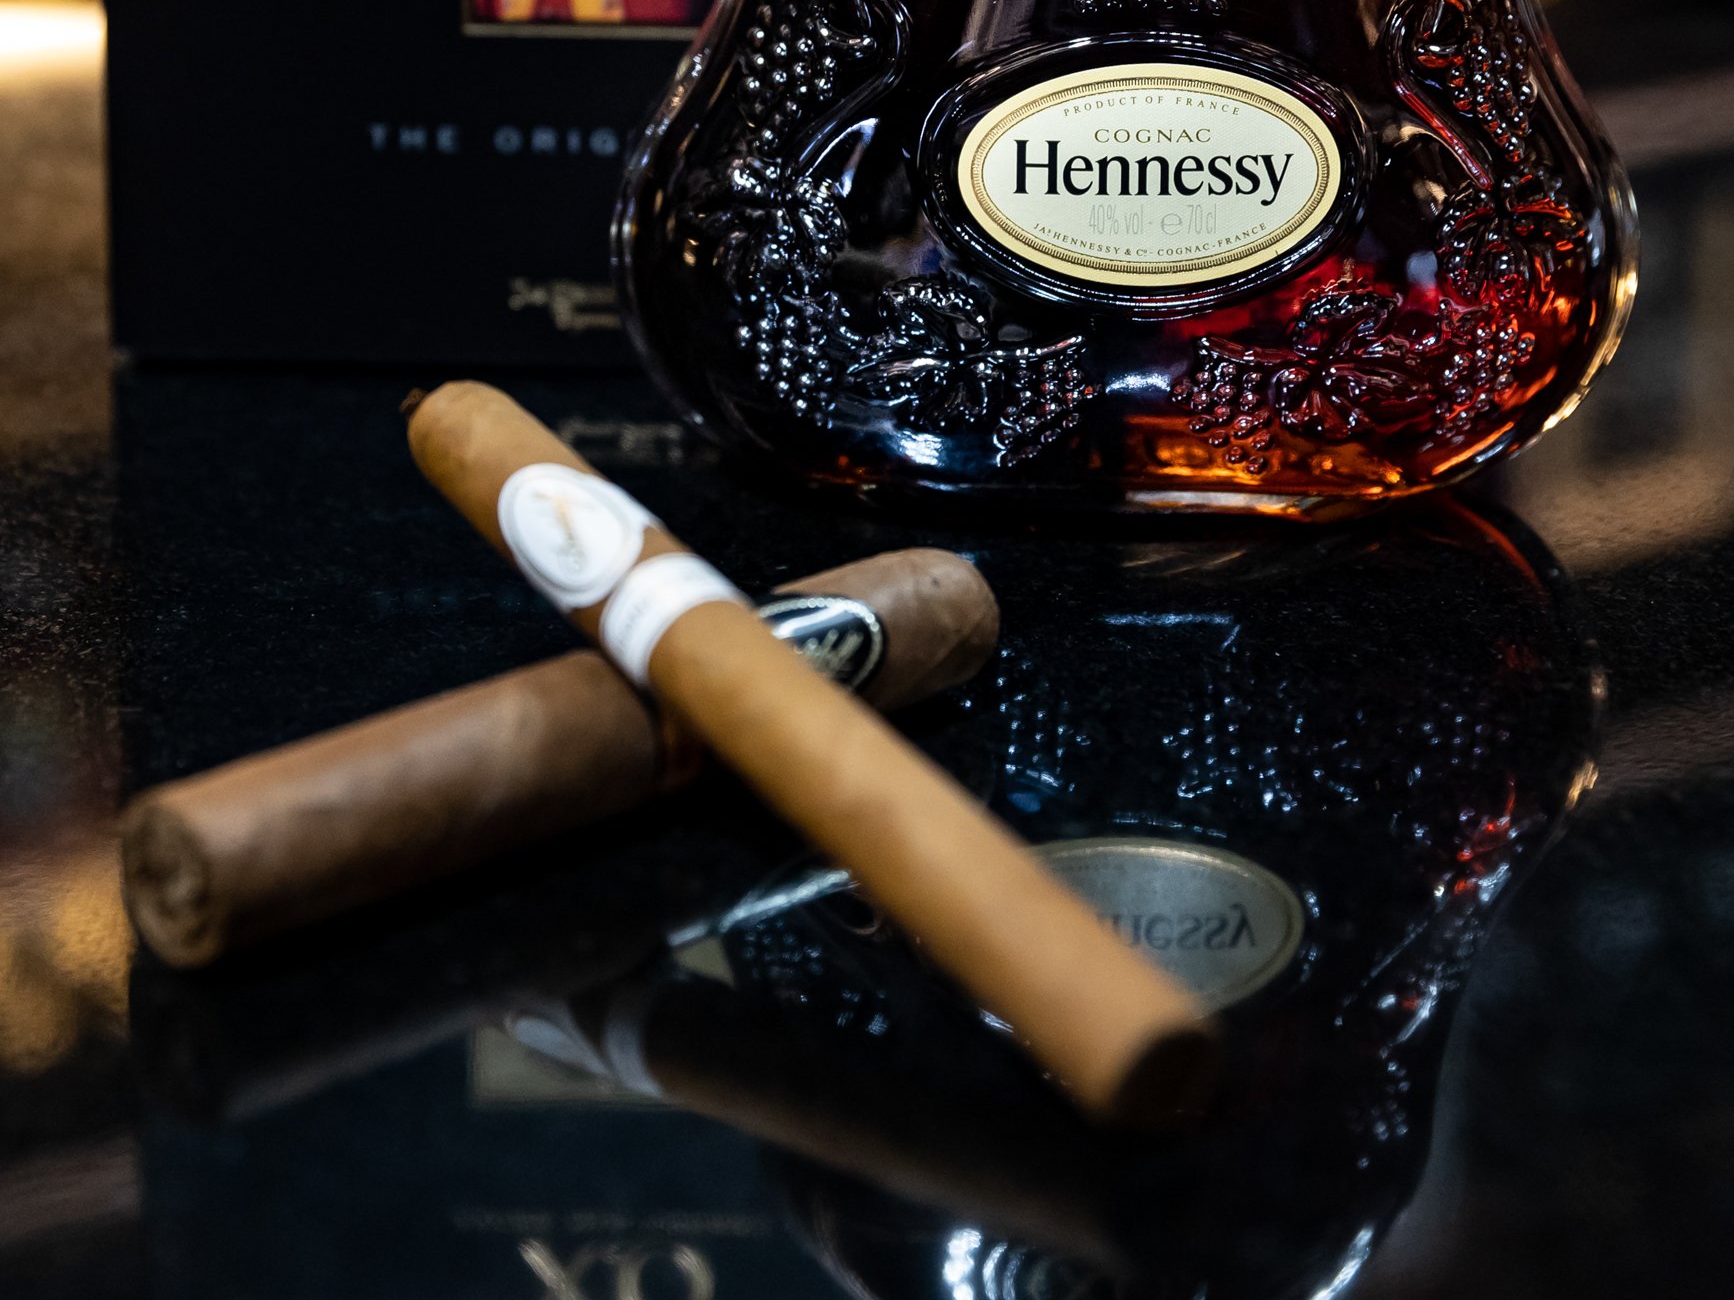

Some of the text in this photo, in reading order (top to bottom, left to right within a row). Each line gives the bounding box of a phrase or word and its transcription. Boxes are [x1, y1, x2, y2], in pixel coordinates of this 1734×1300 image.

[1063, 96, 1241, 117] PRODUCT OF FRANCE
[369, 122, 622, 157] THE ORIG
[1094, 128, 1212, 144] COGNAC
[1013, 139, 1295, 207] Hennessy
[1088, 203, 1120, 236] 40%
[1124, 203, 1144, 235] vol
[1052, 231, 1121, 255] HENNESSY
